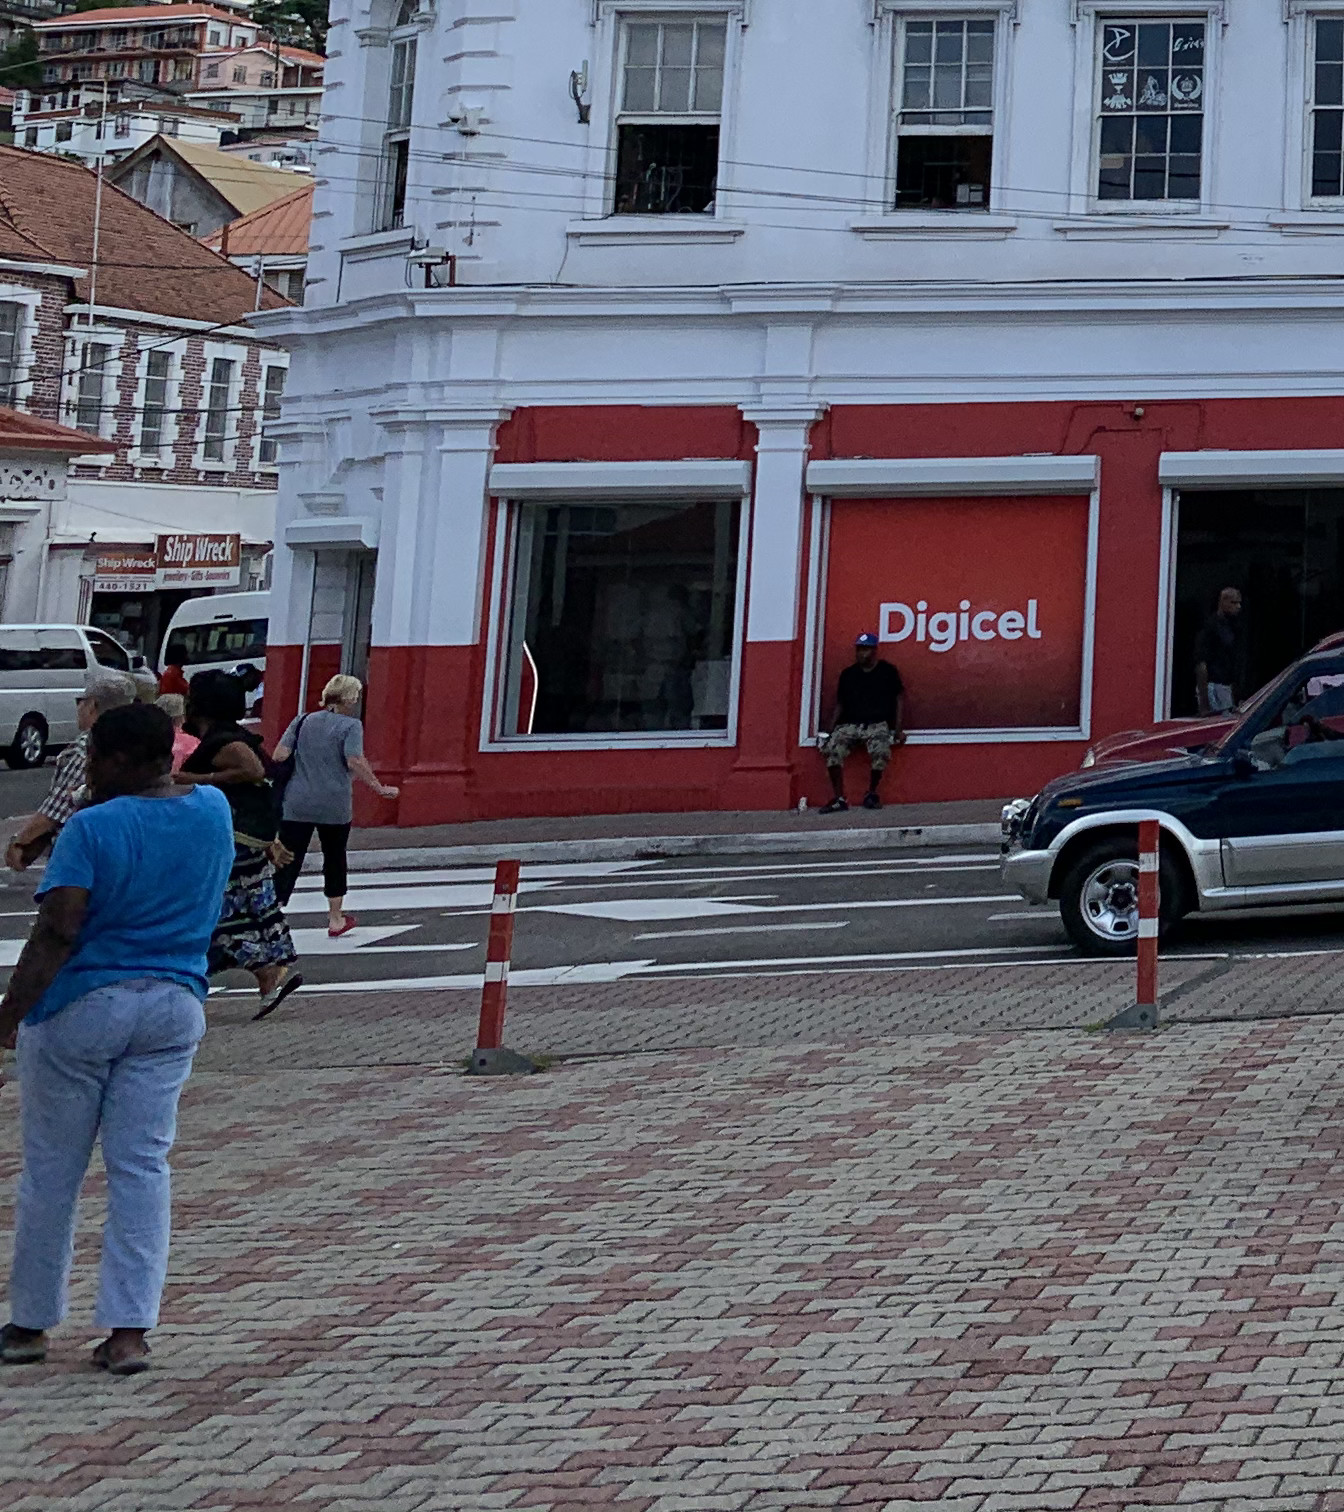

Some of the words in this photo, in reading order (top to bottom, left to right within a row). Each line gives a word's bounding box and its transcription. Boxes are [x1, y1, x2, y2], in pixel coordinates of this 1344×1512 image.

[97, 557, 121, 571] Ship
[122, 557, 155, 569] Wreck
[164, 534, 194, 568] Ship
[196, 535, 234, 562] Wreck
[879, 598, 1042, 652] Digicel
